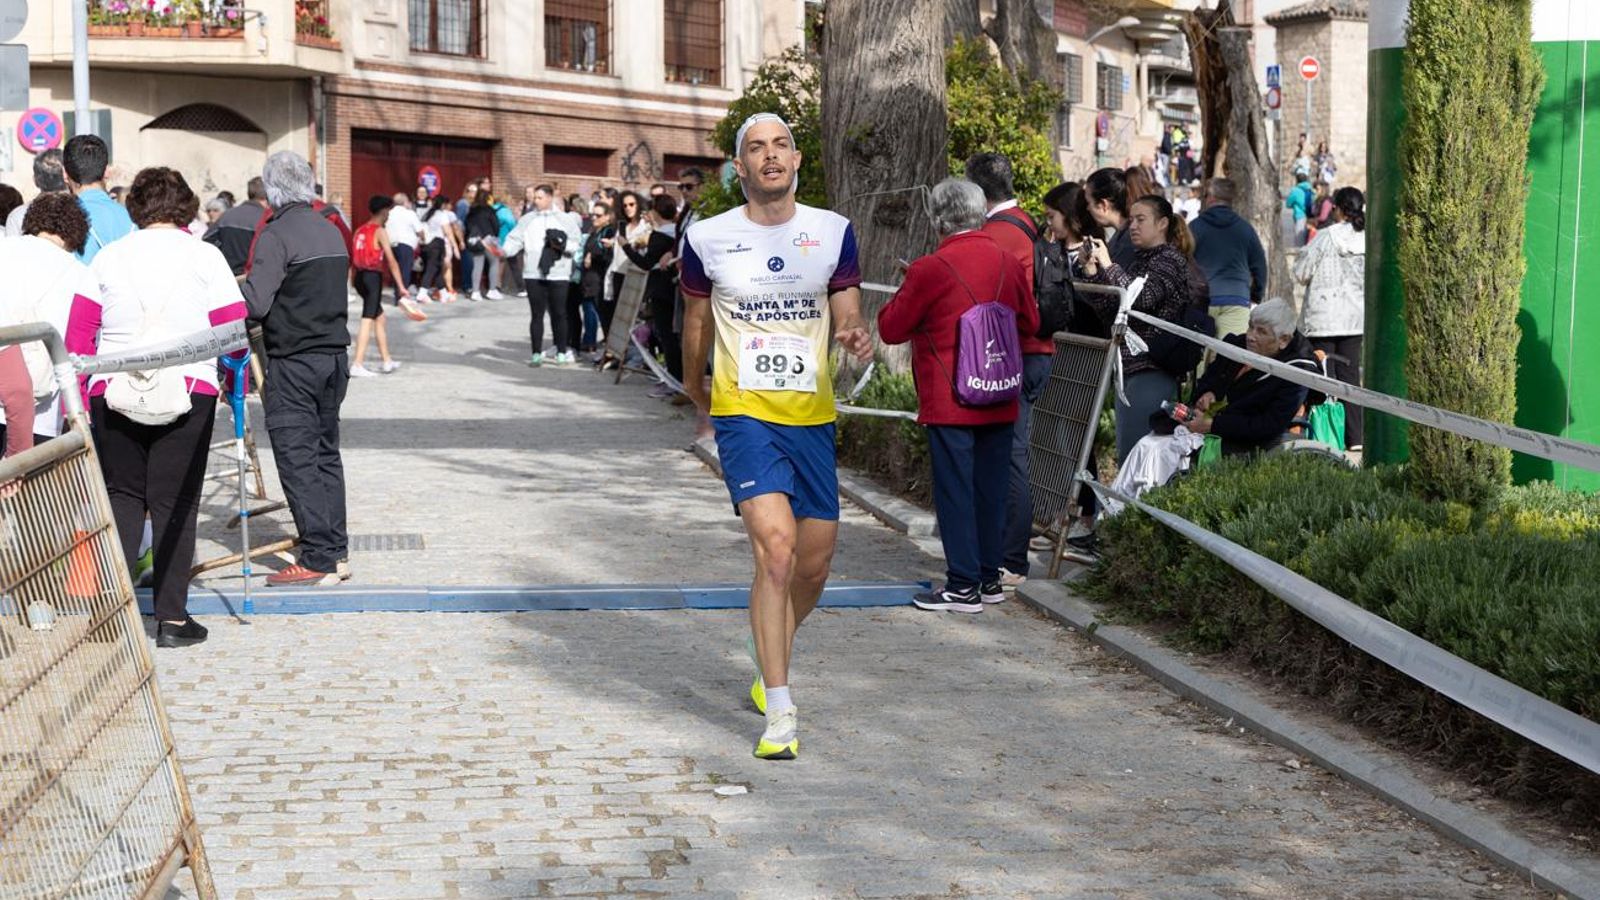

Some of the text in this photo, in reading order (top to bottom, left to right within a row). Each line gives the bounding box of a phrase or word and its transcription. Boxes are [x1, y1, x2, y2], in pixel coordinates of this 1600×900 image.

[734, 294, 759, 303] CLUB
[762, 293, 774, 301] DE
[738, 300, 779, 311] SANTA
[801, 298, 816, 308] DE
[730, 311, 751, 322] LOS
